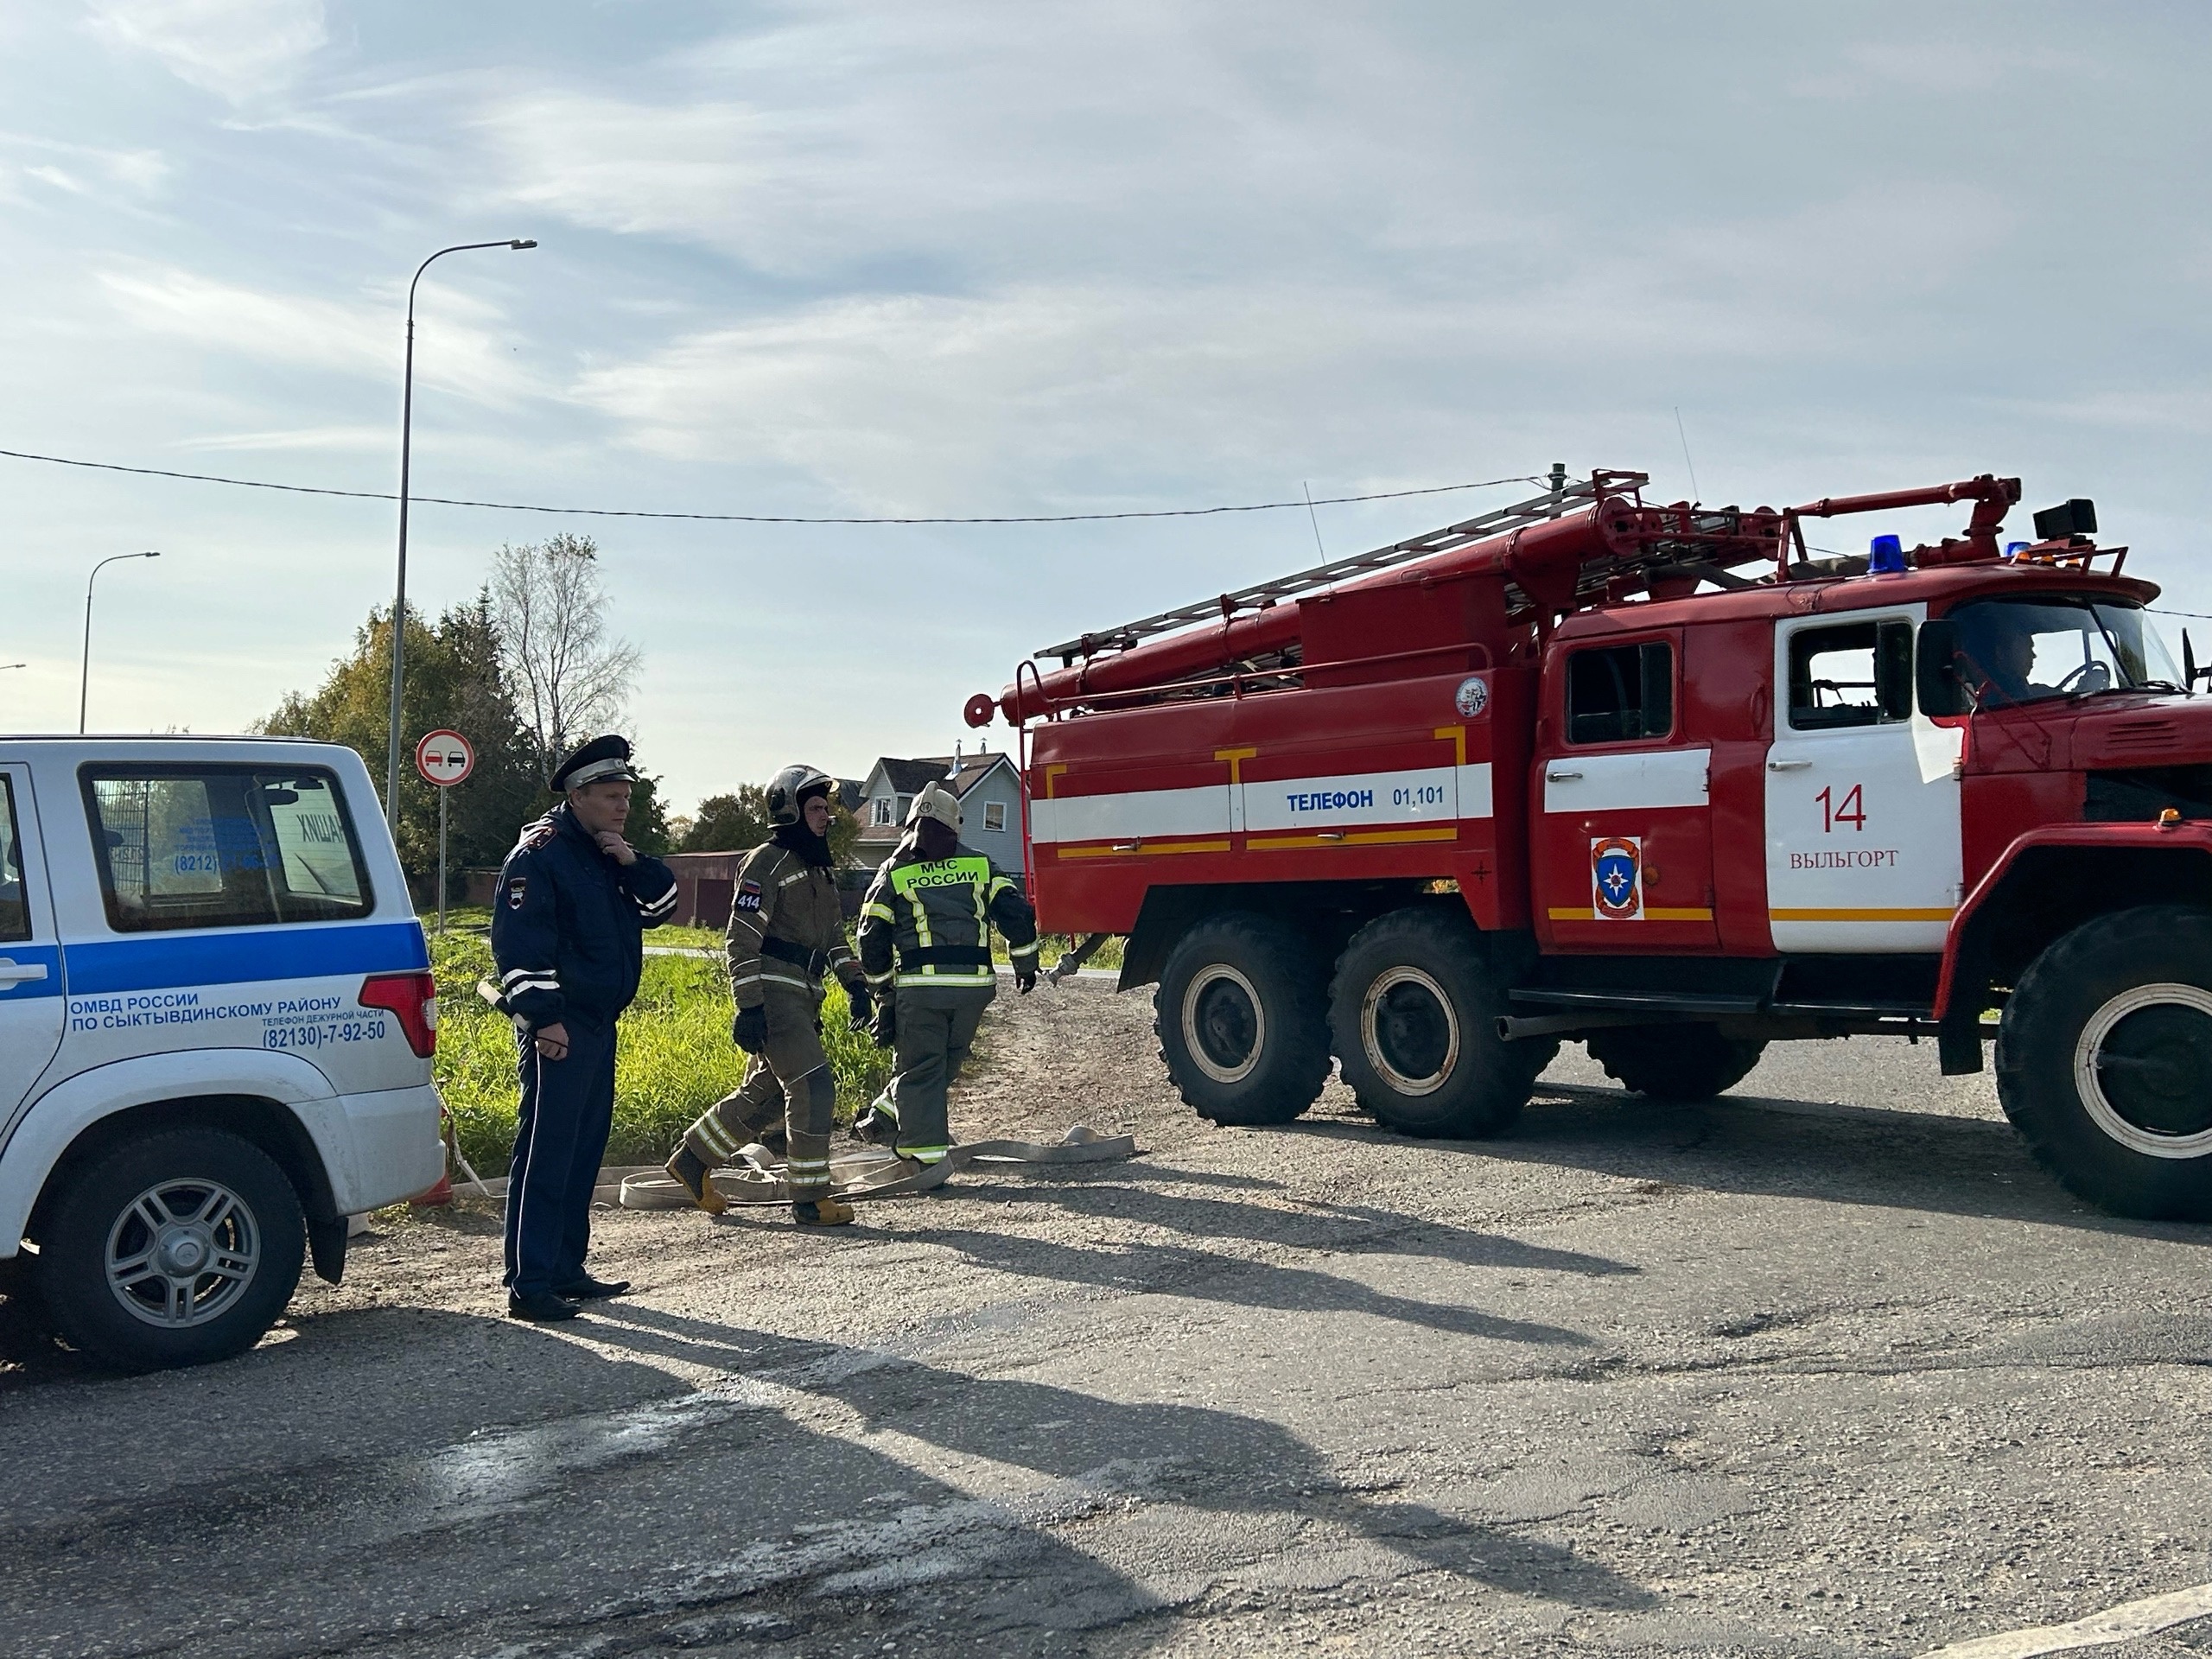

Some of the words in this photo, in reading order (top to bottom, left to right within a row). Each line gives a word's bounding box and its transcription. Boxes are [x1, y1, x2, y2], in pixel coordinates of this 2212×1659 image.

[1287, 789, 1374, 812] ТЕЛЕФОН
[1393, 785, 1443, 807] 01,101
[1815, 785, 1866, 833] 14
[919, 860, 958, 874] МЧС
[1789, 849, 1900, 869] ВЫЛЬГОРТ
[906, 871, 979, 889] РОССИИ
[737, 894, 760, 909] 414
[70, 998, 123, 1014] ОМВД
[127, 994, 199, 1010] РОССИИ
[73, 1017, 98, 1032] ПО
[103, 1002, 273, 1029] СЫКТЫВДИНСКОМУ
[277, 996, 341, 1014] РАЙОНУ
[262, 1017, 304, 1027] ТЕЛЕФОН
[306, 1010, 355, 1024] ДЕЖУРНОЙ
[356, 1008, 385, 1019] ЧАСТИ
[263, 1020, 385, 1049] (82130)-7-92-50
